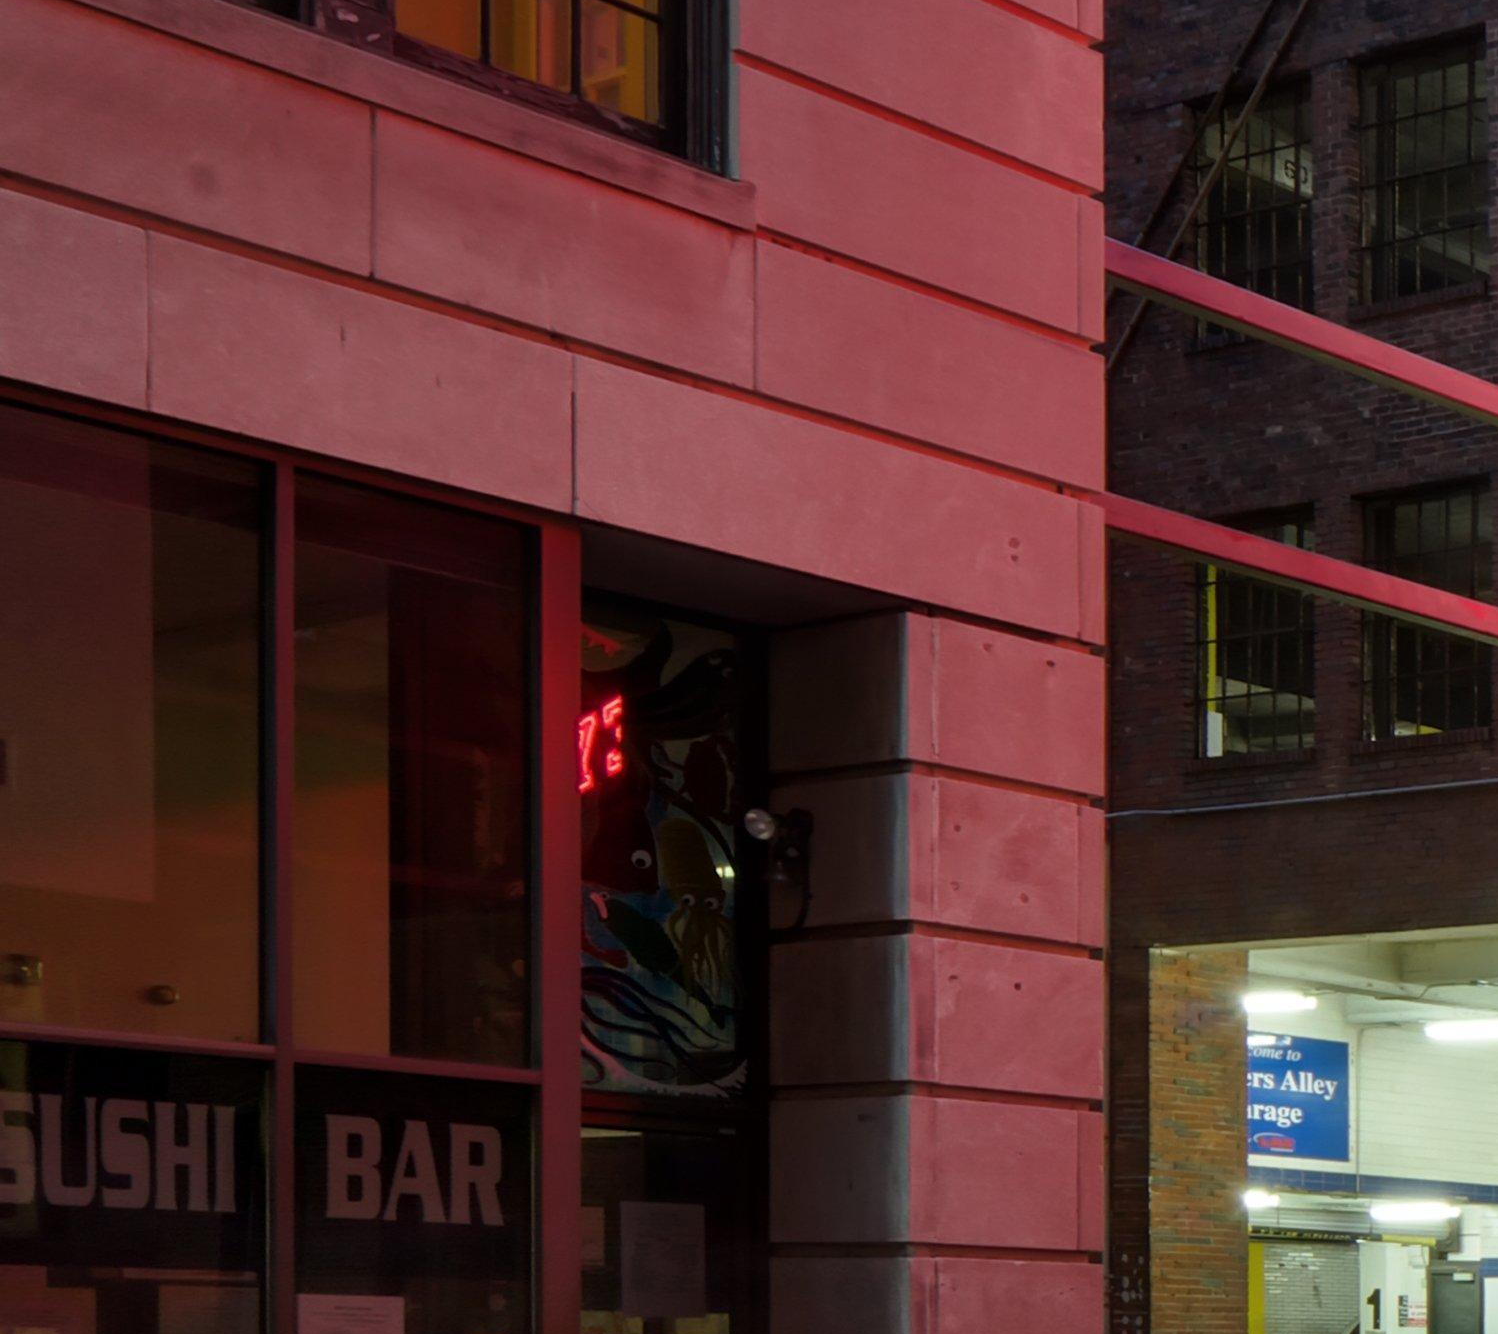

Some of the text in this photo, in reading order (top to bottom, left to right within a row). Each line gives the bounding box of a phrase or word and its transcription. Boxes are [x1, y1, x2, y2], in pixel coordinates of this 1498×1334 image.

[1286, 1049, 1302, 1062] to
[1280, 1069, 1338, 1101] Alley
[0, 1090, 506, 1227] SUSHI BAR
[1366, 1288, 1381, 1330] 1
